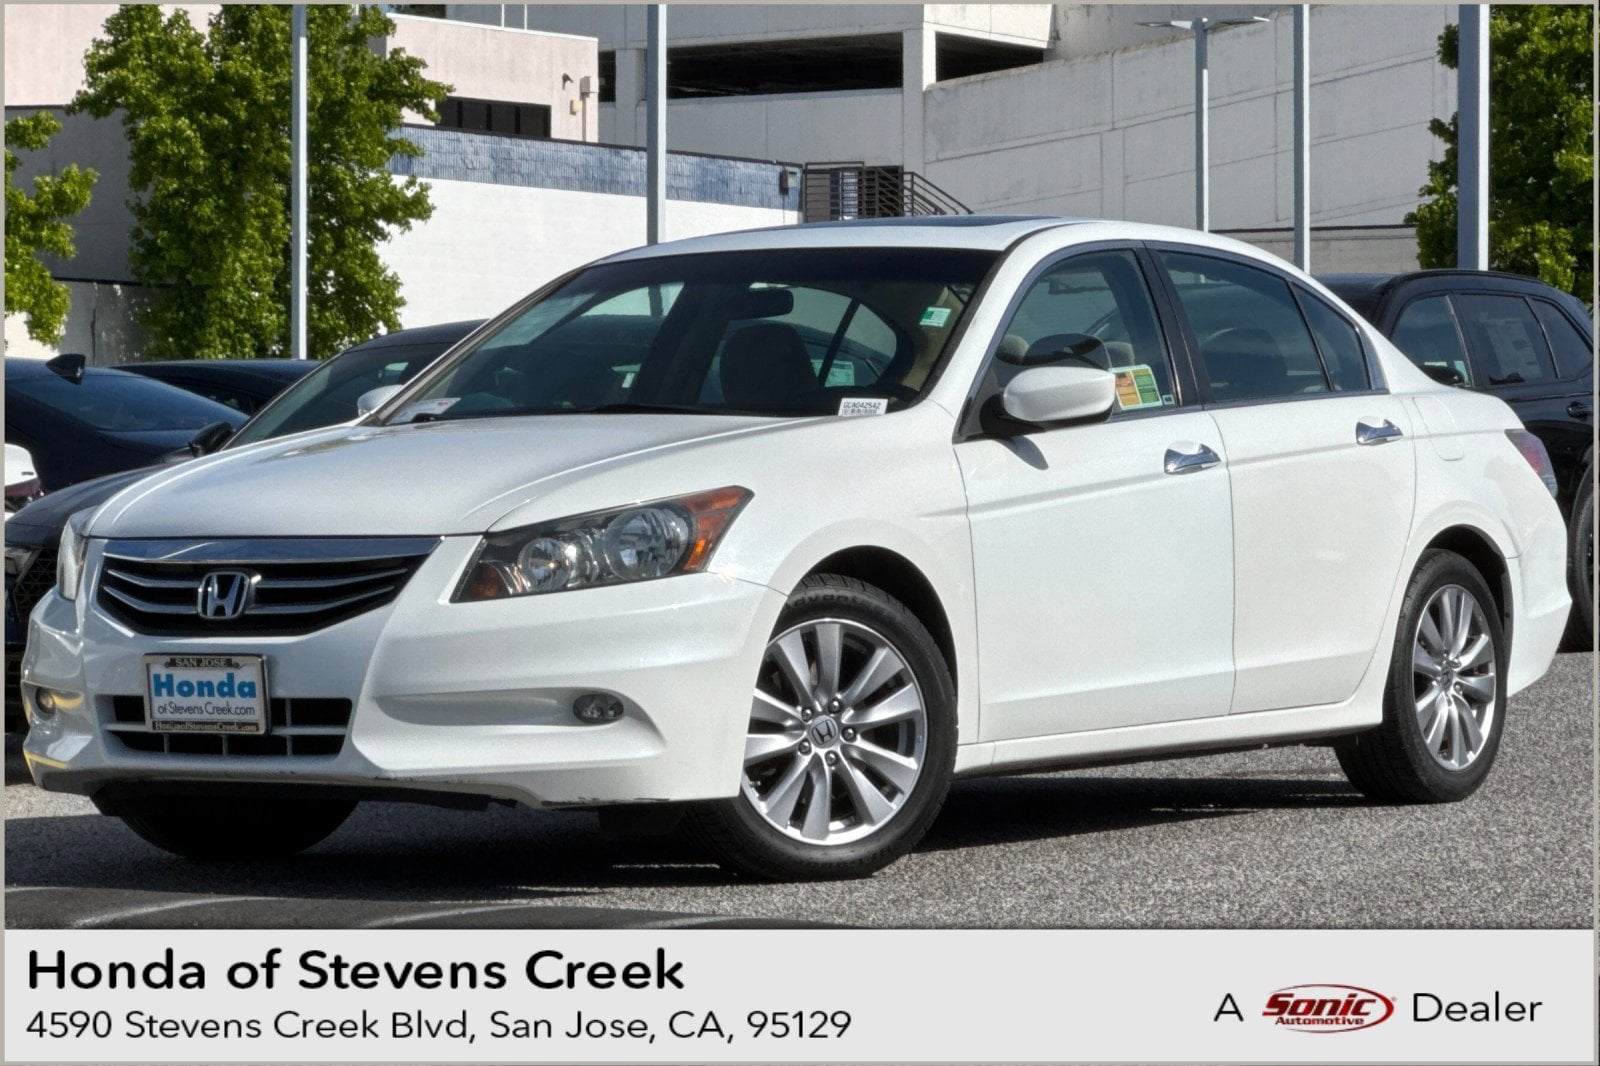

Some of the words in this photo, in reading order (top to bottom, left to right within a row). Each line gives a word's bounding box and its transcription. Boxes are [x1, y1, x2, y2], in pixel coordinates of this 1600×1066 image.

[175, 658, 197, 668] SAN
[199, 658, 227, 668] JOSE
[153, 672, 256, 697] Honda
[157, 704, 167, 714] of
